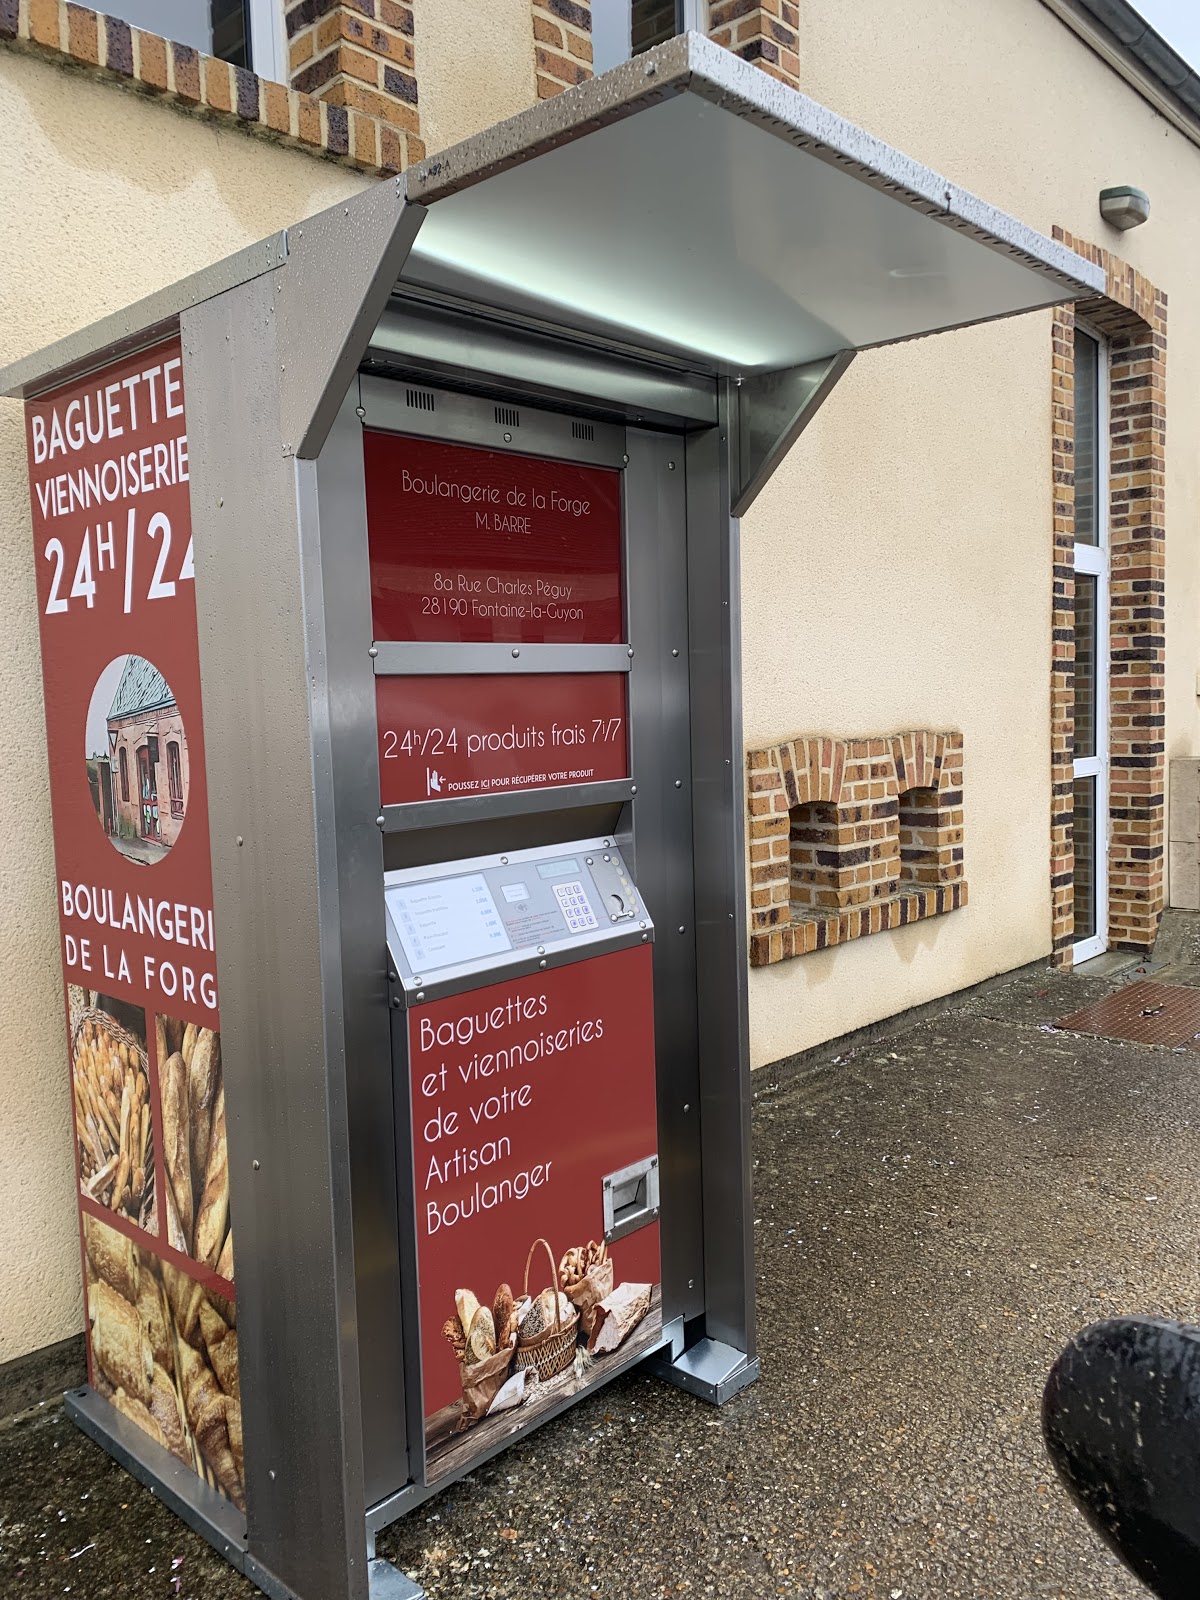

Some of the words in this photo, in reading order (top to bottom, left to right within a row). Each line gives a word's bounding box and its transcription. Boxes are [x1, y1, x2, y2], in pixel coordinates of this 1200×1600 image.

[32, 357, 184, 464] BAGUETTE
[402, 469, 500, 504] Boulangerie
[506, 486, 527, 507] de
[532, 488, 546, 509] la
[551, 491, 591, 516] Forge
[475, 512, 490, 530] M.
[494, 515, 531, 534] BARRE
[421, 597, 468, 616] 28190
[472, 599, 584, 622] Fontaine-la-Guyon
[433, 573, 453, 591] 8a
[457, 574, 481, 593] Rue
[486, 576, 533, 596] Charles
[536, 579, 572, 600] Péguy
[467, 724, 545, 757] produits
[551, 723, 586, 745] frais
[448, 780, 480, 791] POUSSEZ
[481, 780, 490, 789] ICI
[491, 777, 510, 787] POUR
[511, 773, 547, 785] RÉCUPÉRER
[548, 771, 568, 781] VOTRE
[569, 769, 594, 779] PRODUIT
[61, 880, 214, 952] BOULANGERI
[65, 934, 92, 972] DE
[103, 944, 132, 984] LA
[143, 955, 218, 1010] FORG
[420, 994, 548, 1052] Baguettes
[421, 1063, 448, 1097] et
[458, 1018, 604, 1083] viennoiseries
[423, 1106, 459, 1143] de
[469, 1084, 532, 1125] votre
[425, 1136, 511, 1191] Artisan
[426, 1160, 552, 1235] Boulanger
